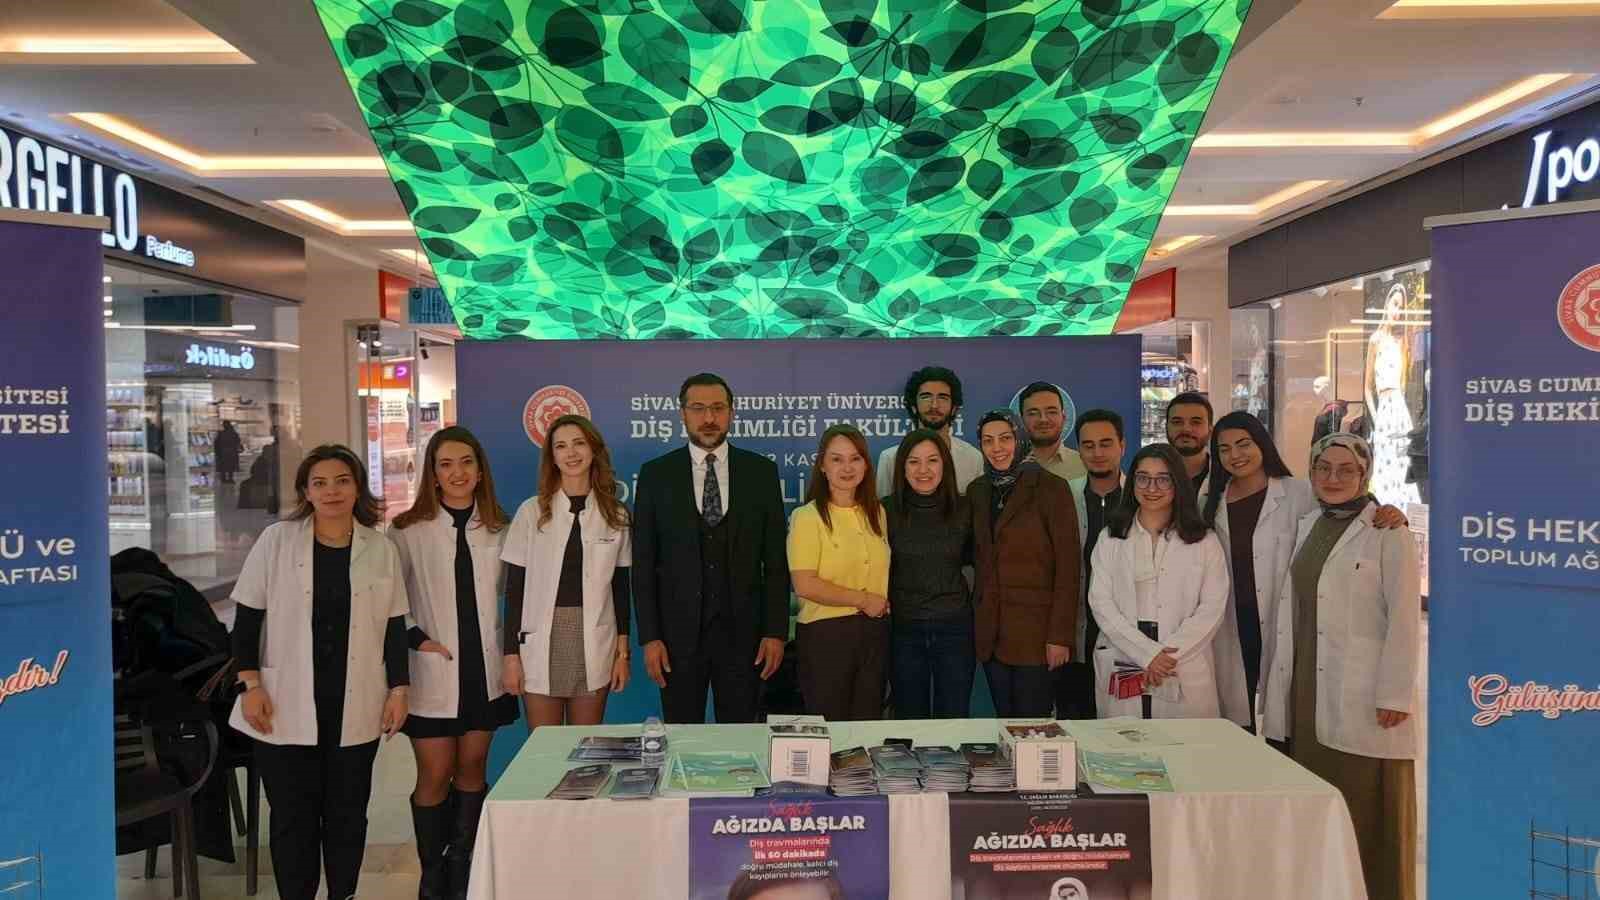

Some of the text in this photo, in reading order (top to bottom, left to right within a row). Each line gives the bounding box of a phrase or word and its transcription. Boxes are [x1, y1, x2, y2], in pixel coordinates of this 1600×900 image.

[0, 385, 69, 405] İTESİ
[1466, 376, 1532, 394] SİVAS
[732, 392, 822, 410] HURİYET
[1464, 396, 1600, 427] DİŞ HEKİ
[630, 415, 673, 443] DİŞ
[784, 452, 819, 467] KAS
[1461, 511, 1517, 544] DİŞ
[1527, 518, 1600, 545] HEK
[36, 537, 76, 557] ve
[1459, 547, 1600, 570] TOPLUM AĞ
[1468, 673, 1600, 727] Gülüşün
[712, 815, 865, 834] AĞIZDA BAŞLAR
[973, 832, 1127, 850] AĞIZDA BAŞLAR
